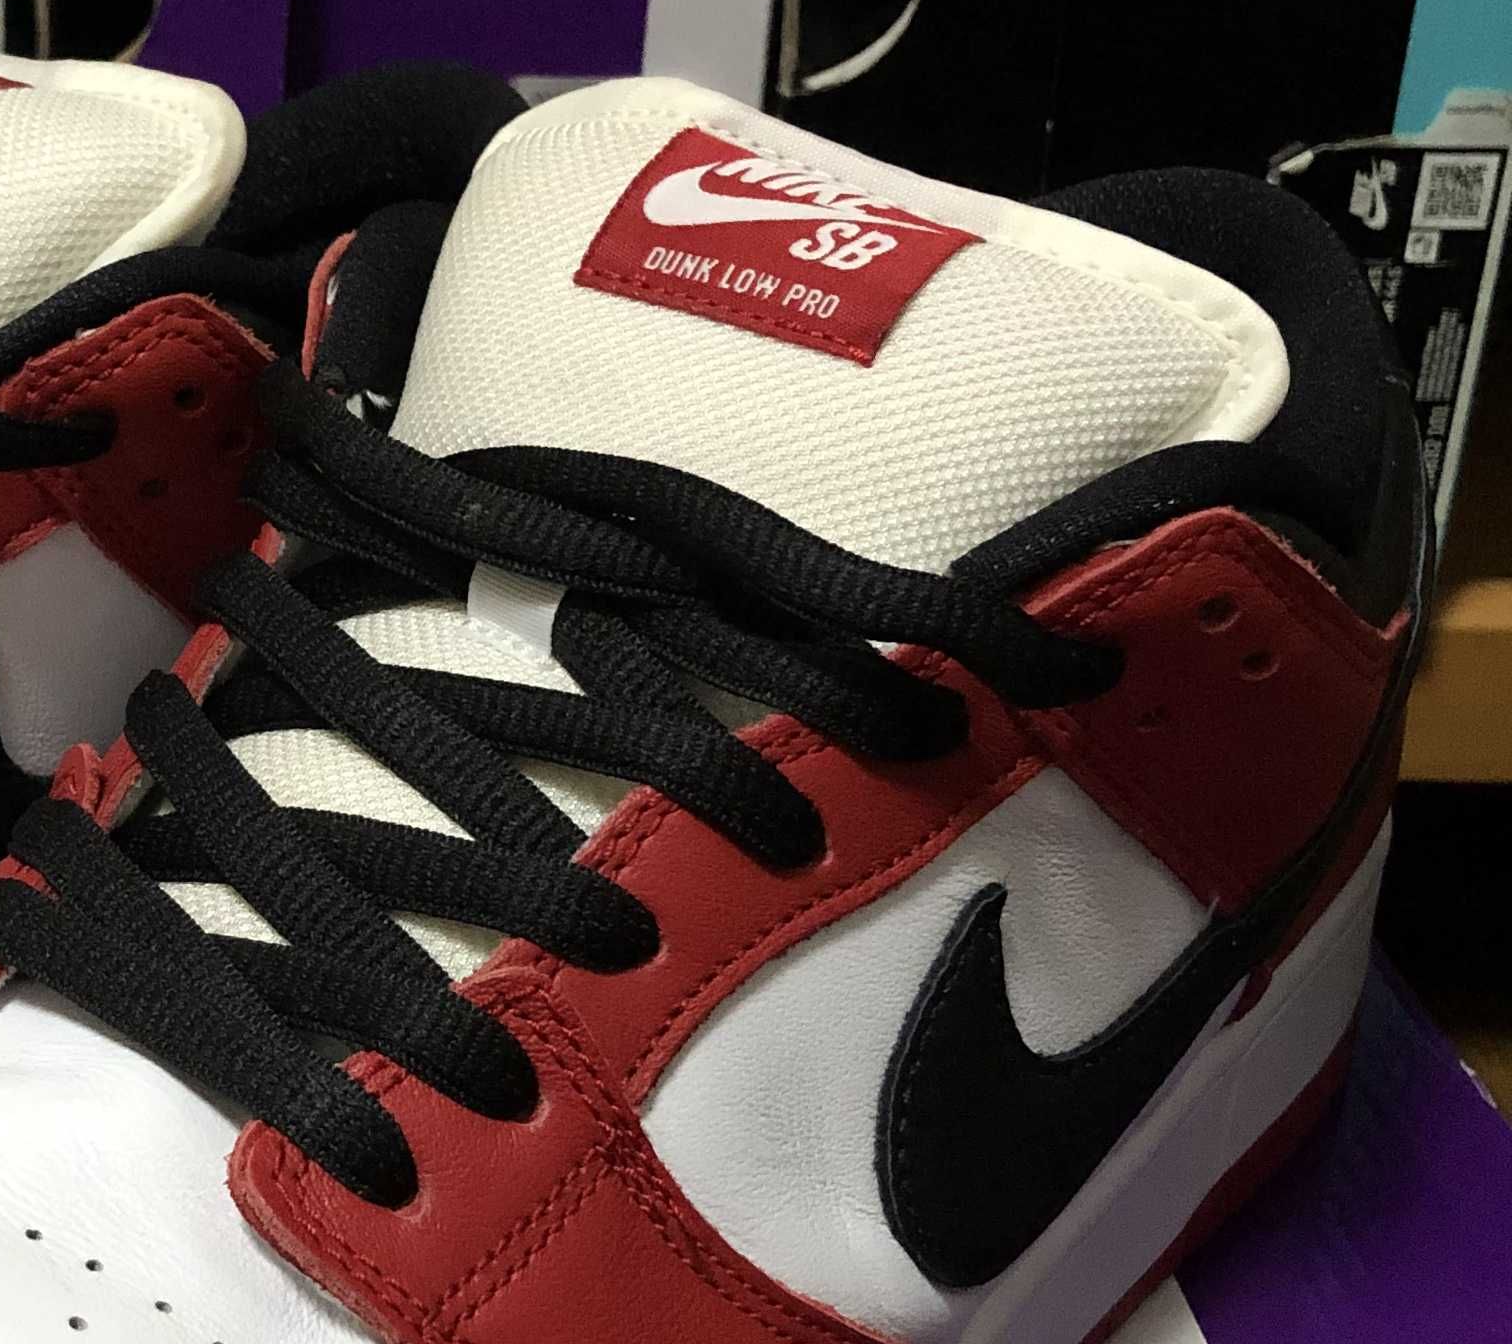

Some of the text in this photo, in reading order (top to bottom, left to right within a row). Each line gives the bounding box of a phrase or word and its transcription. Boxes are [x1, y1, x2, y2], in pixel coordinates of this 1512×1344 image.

[789, 221, 898, 270] SB
[643, 246, 840, 319] DUNK LOW PRO
